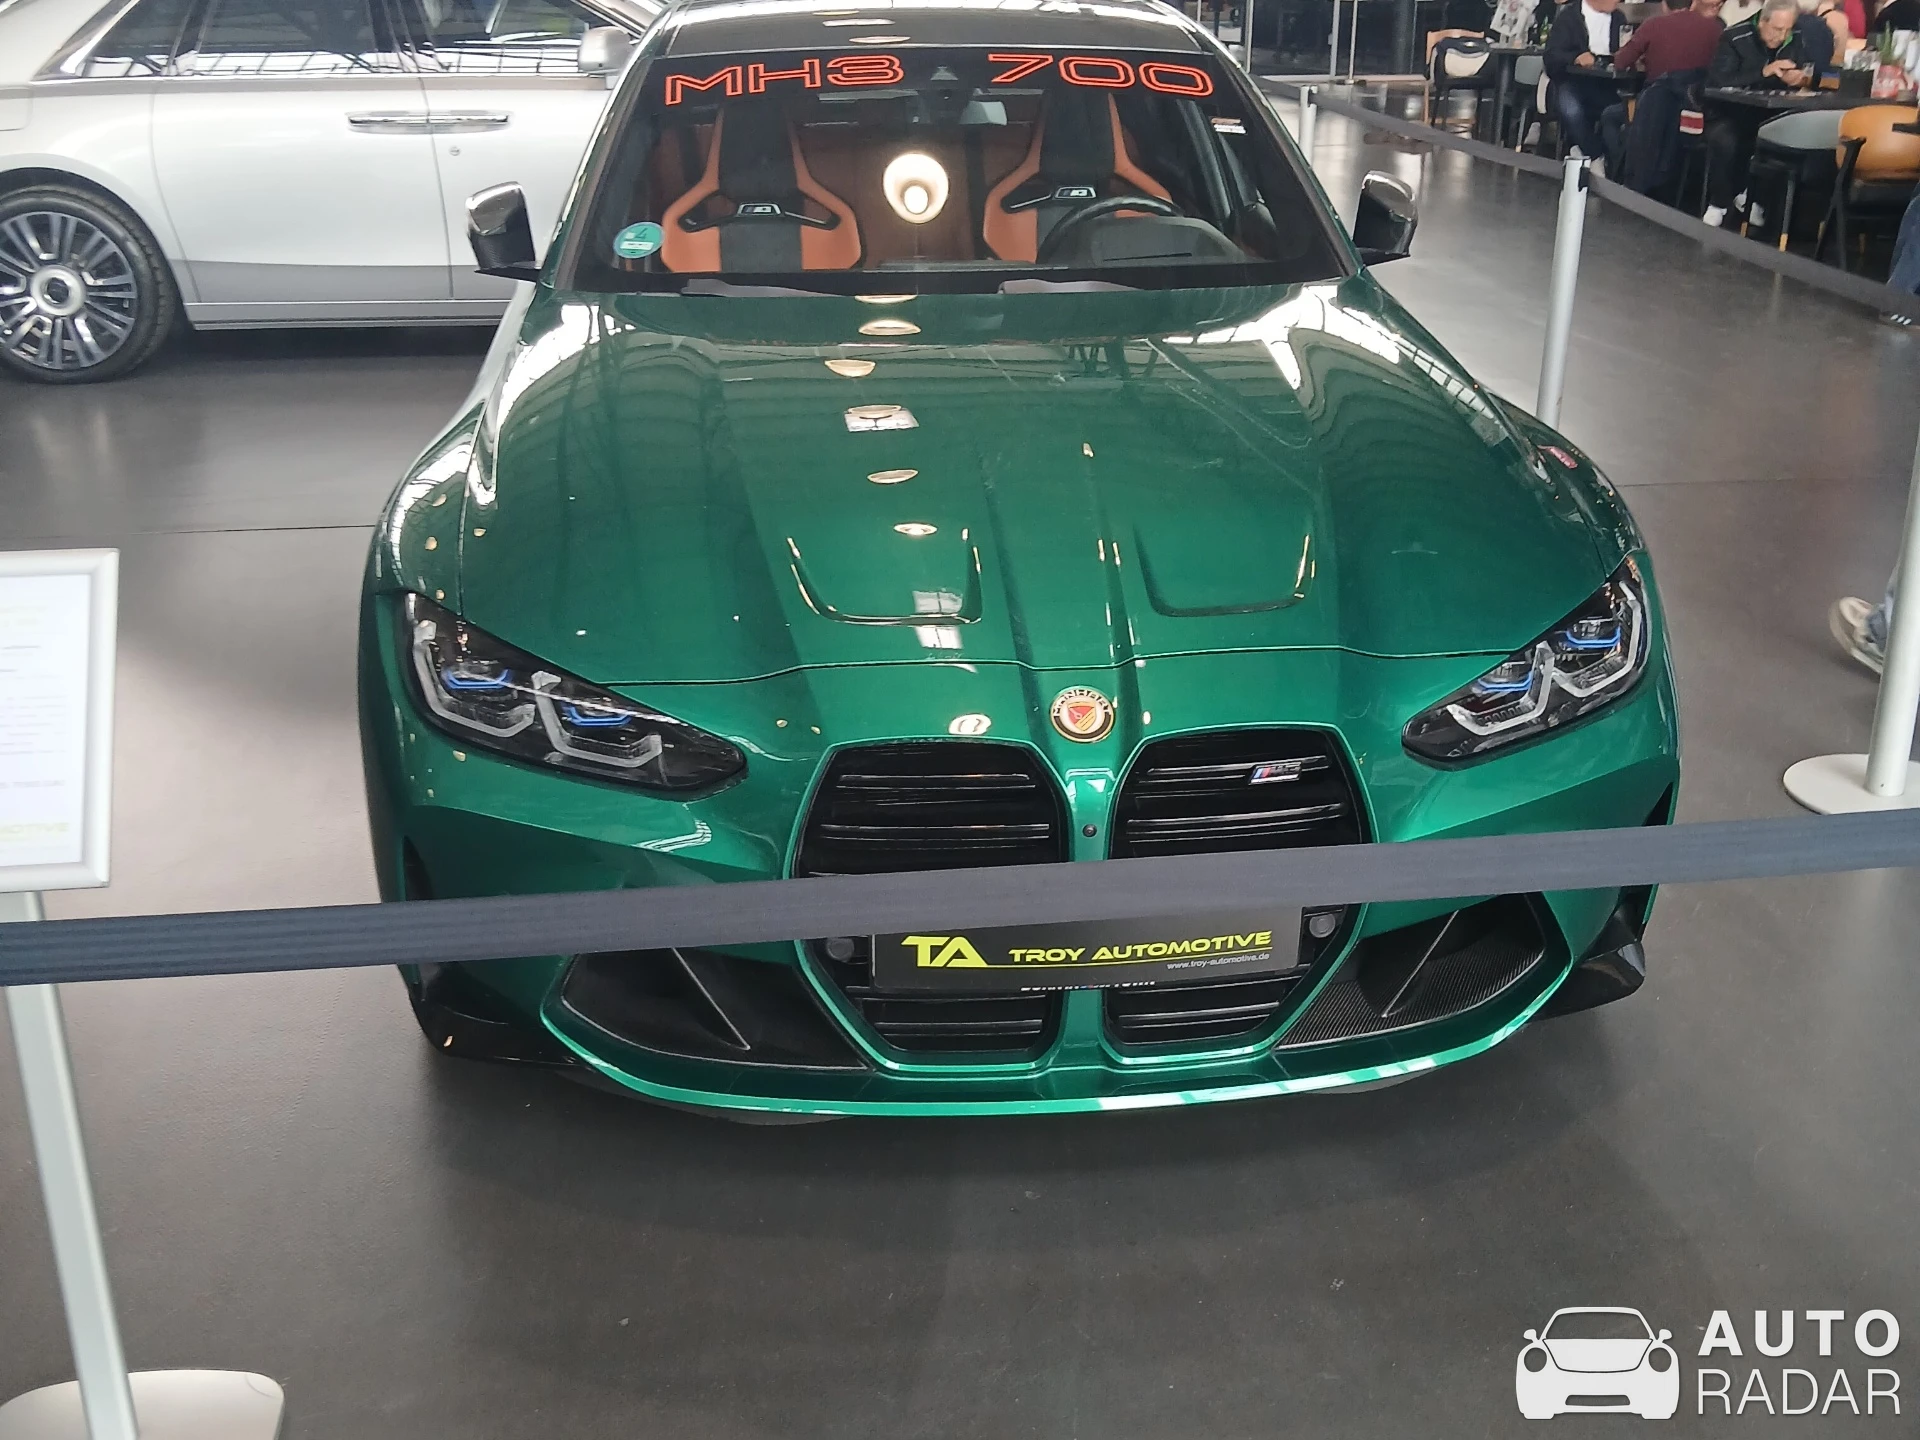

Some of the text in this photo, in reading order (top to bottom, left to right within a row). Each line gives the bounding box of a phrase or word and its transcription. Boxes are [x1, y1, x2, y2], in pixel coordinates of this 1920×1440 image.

[665, 54, 1214, 105] MH3 700
[902, 936, 988, 967] TA
[1008, 930, 1272, 963] TROY AUTOMOTIVE
[1166, 952, 1270, 970] www.troy-automotive.de
